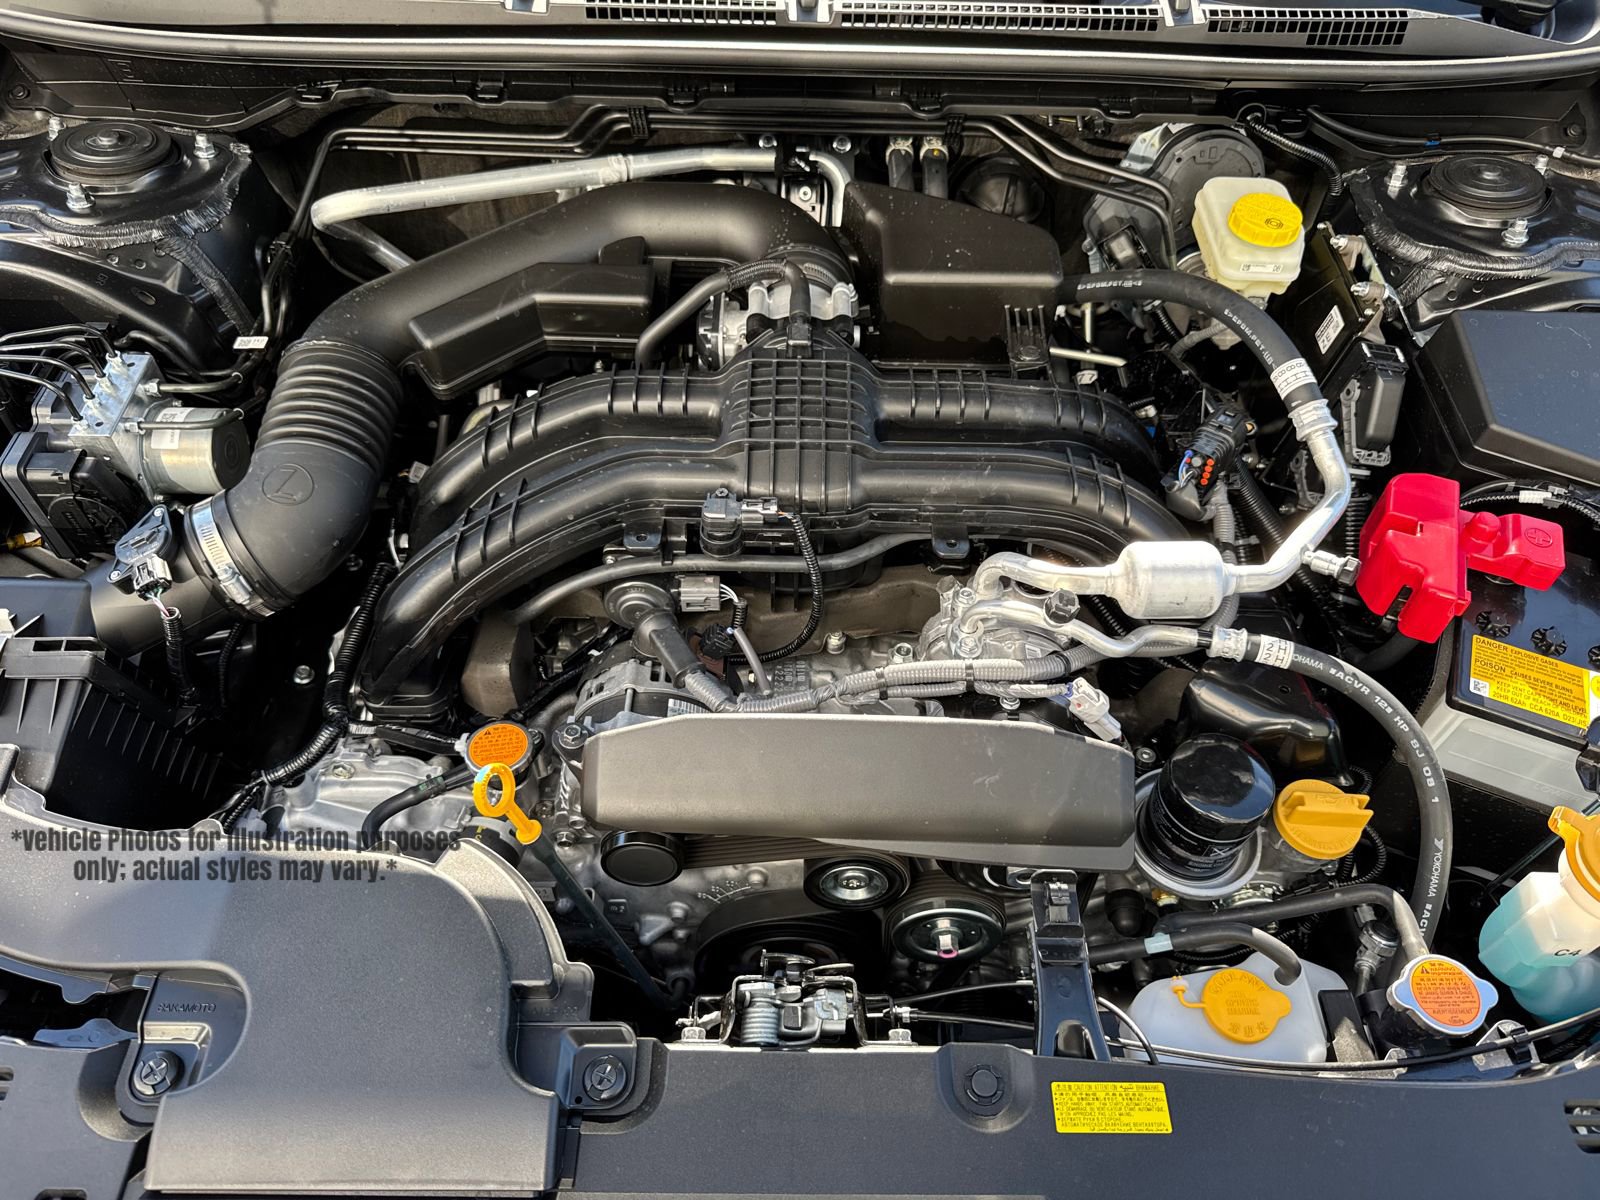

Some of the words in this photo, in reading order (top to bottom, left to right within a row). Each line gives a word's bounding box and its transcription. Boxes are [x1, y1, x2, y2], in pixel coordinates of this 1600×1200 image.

[1475, 637, 1508, 653] DANGER
[1474, 657, 1506, 673] POISON
[1510, 670, 1532, 681] CAUSES
[1292, 654, 1324, 670] OHAMA
[1335, 671, 1371, 695] ACVR
[1393, 715, 1409, 732] HP
[1529, 703, 1544, 713] CCA
[1427, 851, 1443, 897] YOKOHAMA
[1553, 948, 1582, 957] C4
